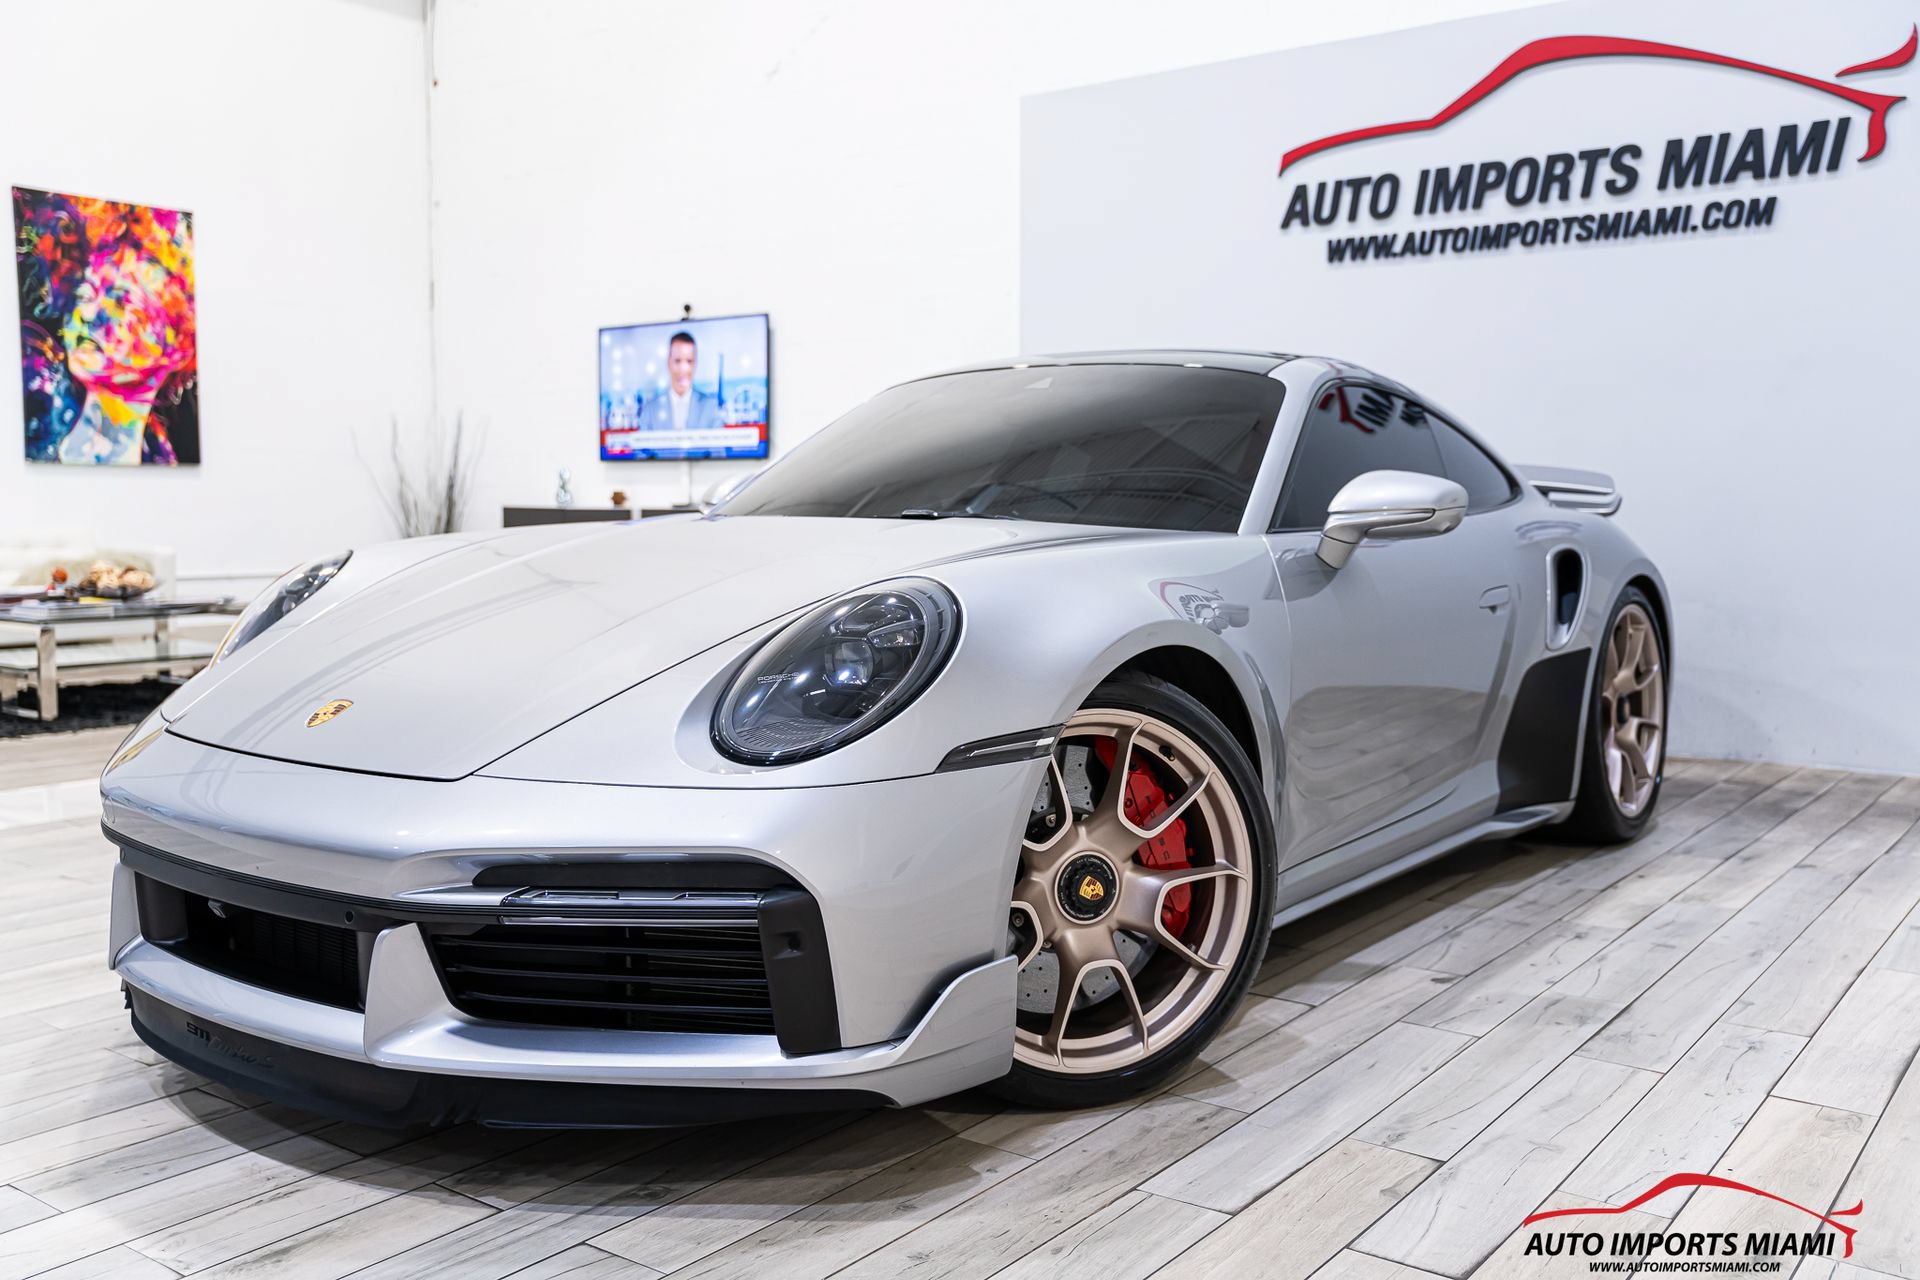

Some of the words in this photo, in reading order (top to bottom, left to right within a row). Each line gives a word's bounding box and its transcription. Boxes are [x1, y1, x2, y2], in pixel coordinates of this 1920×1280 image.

[1281, 173, 1400, 230] AUTO
[1413, 144, 1642, 216] IMPORTS
[1658, 116, 1851, 191] MIAMI
[1328, 196, 1778, 263] WWW.AUTOIMPORTSMIAMI.COM
